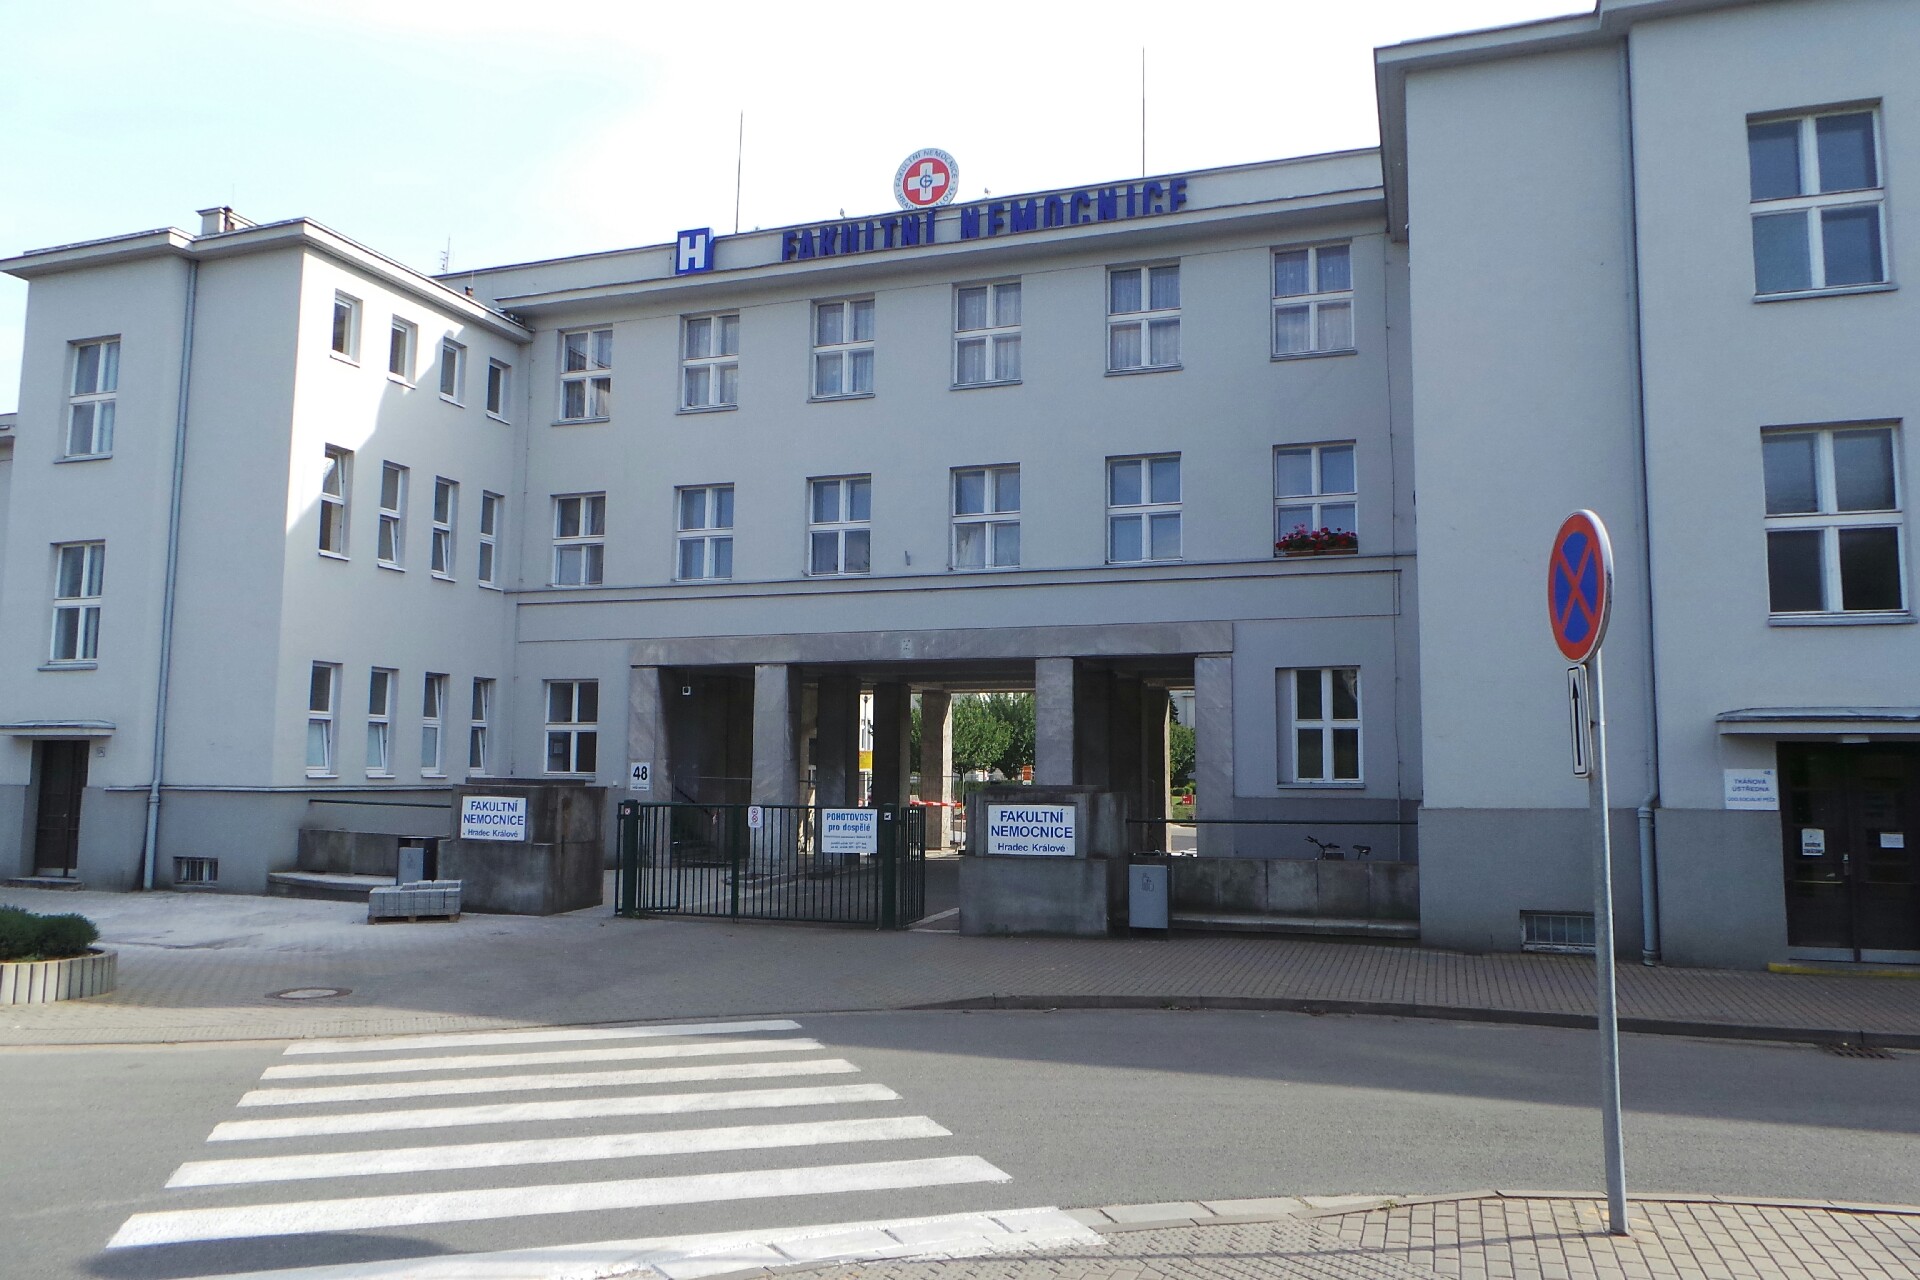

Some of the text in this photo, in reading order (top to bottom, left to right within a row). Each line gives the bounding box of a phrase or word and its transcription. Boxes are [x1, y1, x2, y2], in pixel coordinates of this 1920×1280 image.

[960, 178, 1188, 241] NEMOCNICE
[679, 234, 706, 271] H
[632, 765, 648, 781] 48
[470, 799, 519, 813] FAKULTNÍ
[463, 813, 524, 826] NEMOCNICE
[826, 812, 874, 822] POHOTOVOST
[1000, 808, 1064, 823] FAKULTNÍ
[467, 828, 519, 838] Hradec Králové
[828, 823, 871, 833] pro dospělé
[991, 825, 1074, 839] NEMOCNICE
[997, 842, 1066, 853] Hradec Králové
